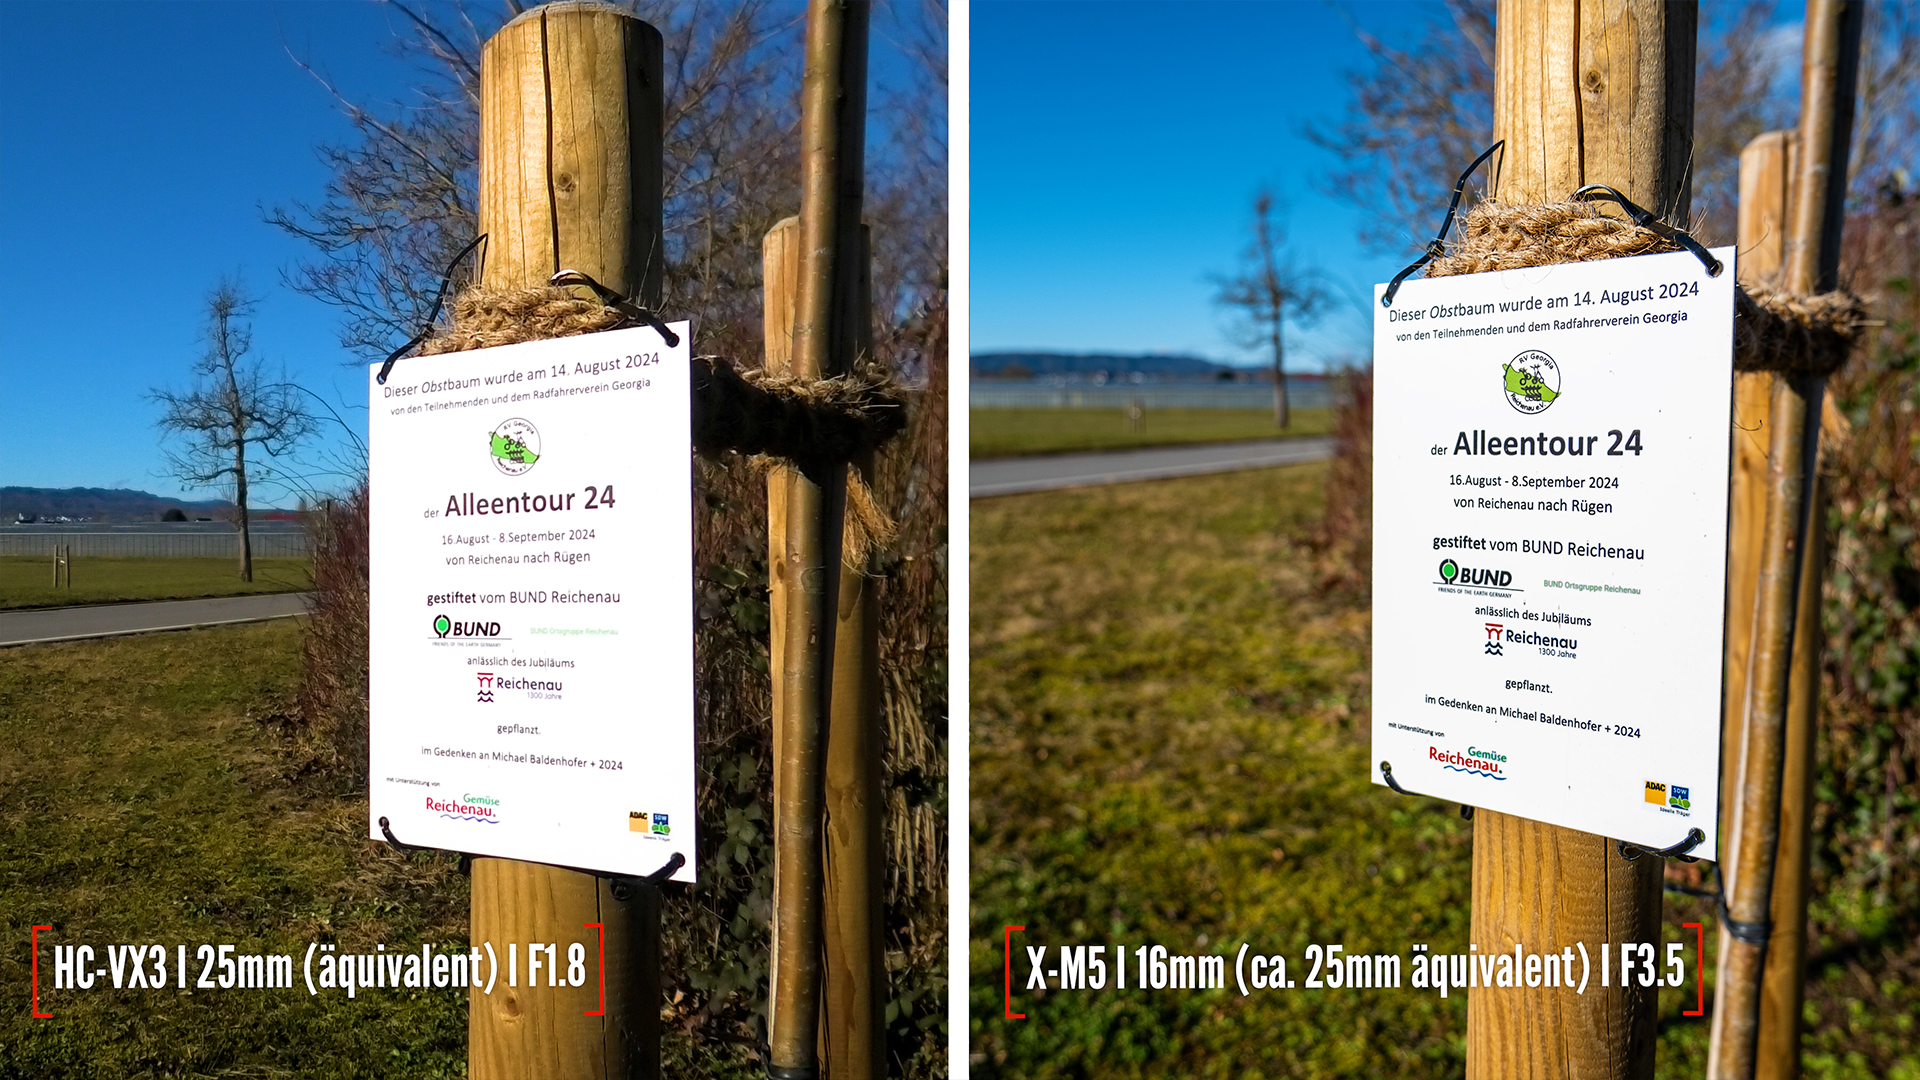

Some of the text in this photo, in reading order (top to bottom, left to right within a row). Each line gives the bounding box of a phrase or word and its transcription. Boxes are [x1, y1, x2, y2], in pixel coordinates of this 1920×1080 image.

[1390, 281, 1699, 323] Dieser Obstbaum wurde am 14. August 2024
[1396, 310, 1688, 341] von den Teilnehmenden und dem Radfahrerverein Georgia
[1519, 353, 1554, 370] RV Georgia
[384, 352, 660, 398] Dieser Obstbaum wurde am 14. August 2024
[390, 377, 651, 415] von den Teilnehmenden und dem Radfahrerverein Georgia
[1430, 429, 1643, 456] der Alleentour 24
[1450, 474, 1502, 488] 16.August
[1511, 475, 1585, 489] 8.September
[1588, 477, 1619, 489] 2024
[424, 485, 616, 519] der Alleentour 24
[1453, 498, 1612, 515] von Reichenau nach Rügen
[442, 534, 490, 546] 16.August
[499, 531, 565, 544] 8.September
[569, 529, 596, 540] 2024
[1432, 536, 1645, 560] gestiftet vom BUND Reichenau
[446, 551, 591, 565] von Reichenau nach Rügen
[1460, 567, 1512, 587] BUND
[1543, 580, 1641, 595] BUND Ortsgruppe Reichenau
[427, 591, 621, 606] gestiftet vom BUND Reichenau
[1475, 605, 1592, 627] anlässlich des Jubiläums
[453, 622, 501, 637] BUND
[1506, 629, 1578, 649] Reichenau
[467, 656, 575, 669] anlässlich des Jubiläums
[1538, 648, 1577, 660] 1300 Jahre
[497, 677, 562, 691] Reichenau
[1505, 679, 1553, 693] gepflanzt.
[544, 692, 562, 700] Jahre
[1425, 694, 1641, 739] im Gedenken an Michael Baldenhofer + 2024
[497, 724, 543, 735] gepflanzt.
[1398, 722, 1433, 738] Unterstützung
[421, 745, 432, 756] im
[434, 747, 477, 759] Gedenken
[479, 751, 490, 760] an
[492, 752, 528, 763] Michael
[530, 754, 587, 768] Baldenhofer
[599, 760, 623, 771] 2024
[1429, 746, 1503, 774] Reichenau.
[1467, 746, 1507, 763] Gemüse
[1645, 781, 1666, 792] ADAC
[426, 797, 497, 817] Reichenau.
[463, 793, 500, 806] Gemüse
[629, 811, 648, 820] ADAC
